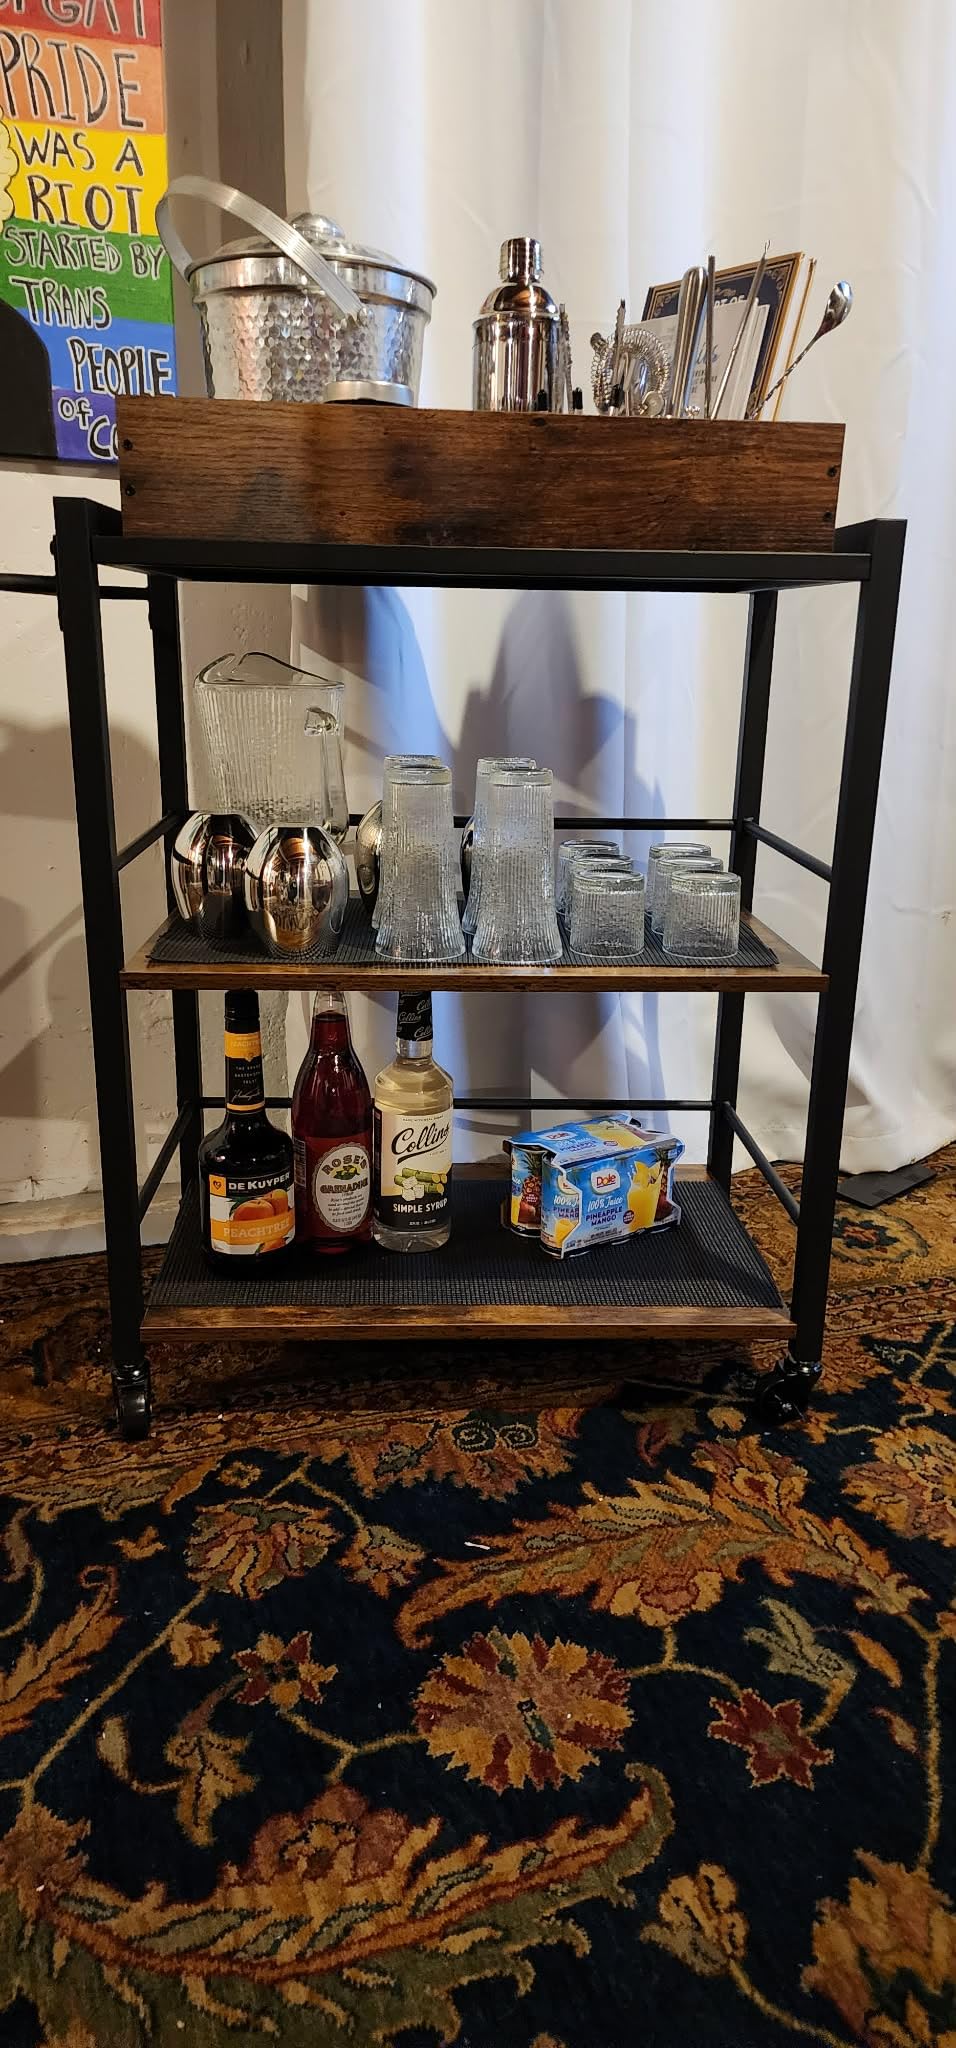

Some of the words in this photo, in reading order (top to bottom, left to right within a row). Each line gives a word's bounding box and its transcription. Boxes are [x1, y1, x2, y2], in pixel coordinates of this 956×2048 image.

[0, 30, 144, 127] PRIDE
[15, 127, 95, 170] WAS
[115, 138, 144, 176] A
[27, 174, 143, 235] RIOT
[5, 226, 121, 272] STARTED
[129, 242, 165, 279] BY
[10, 276, 112, 330] TRANS
[68, 337, 174, 398] PEOPLE
[391, 1122, 449, 1165] Collins
[321, 1154, 367, 1175] ROSE'S
[596, 1173, 617, 1188] Dole
[228, 1182, 246, 1190] DE
[247, 1172, 290, 1191] KUYPER
[393, 1203, 423, 1214] SIMPLE
[425, 1198, 448, 1213] SYRUP
[585, 1206, 623, 1222] PINEAPPLE
[588, 1199, 604, 1213] 100%
[604, 1195, 624, 1209] Juice
[591, 1214, 617, 1227] MANGO
